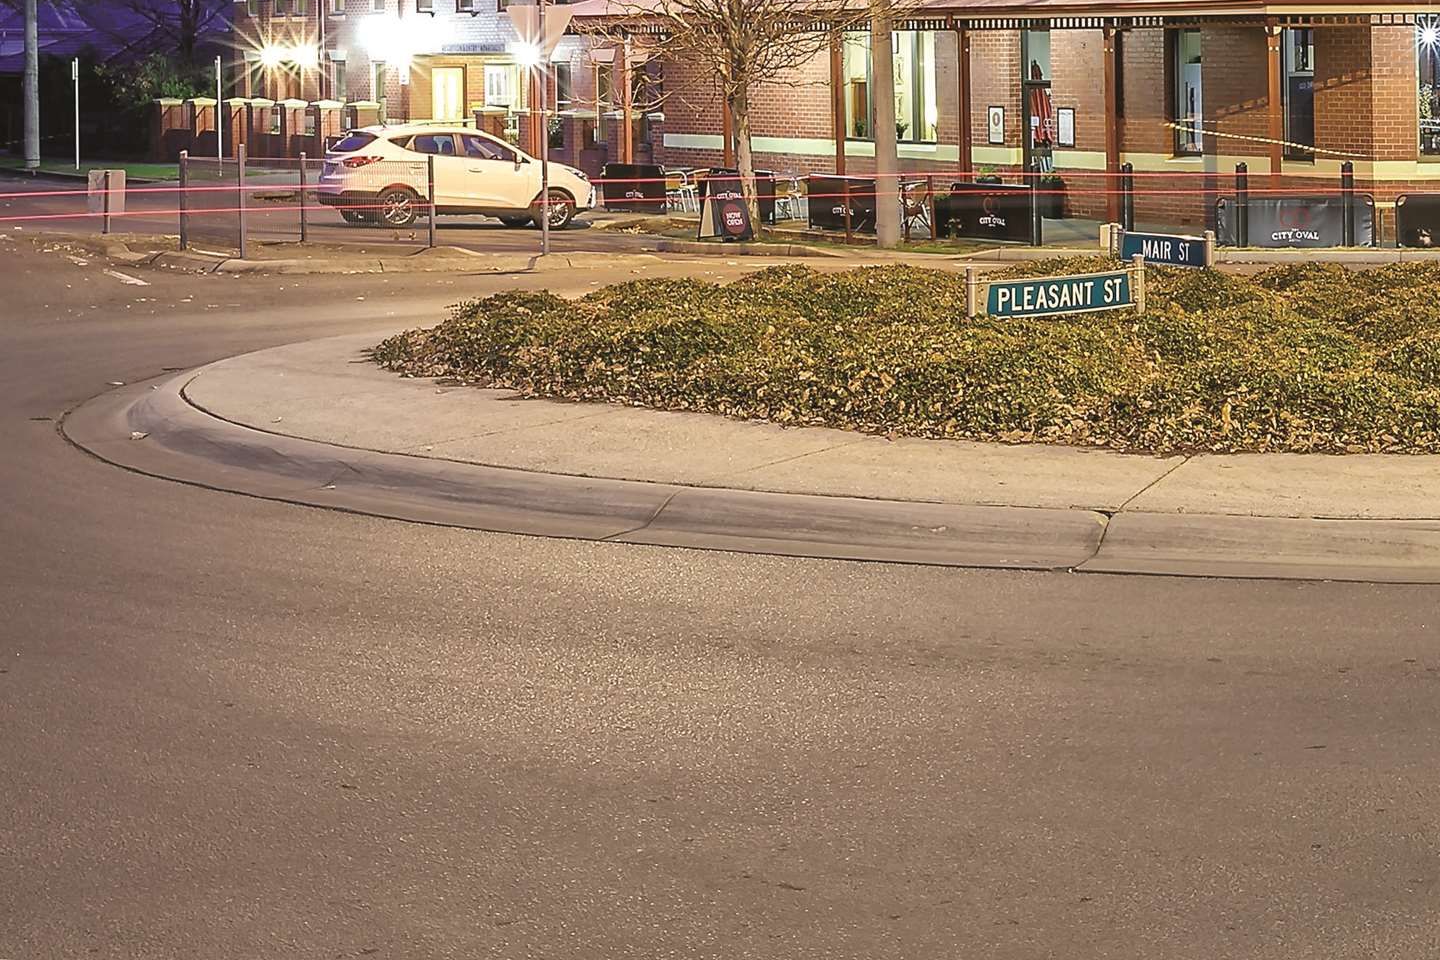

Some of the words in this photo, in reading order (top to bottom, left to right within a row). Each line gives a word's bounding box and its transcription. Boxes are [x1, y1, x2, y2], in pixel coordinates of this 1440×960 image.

[1271, 231, 1294, 240] CITY
[1295, 231, 1319, 240] OVAL
[1142, 240, 1172, 261] MAIR
[1178, 242, 1191, 262] ST
[997, 281, 1094, 313] PLEASANT
[1103, 278, 1123, 304] ST
